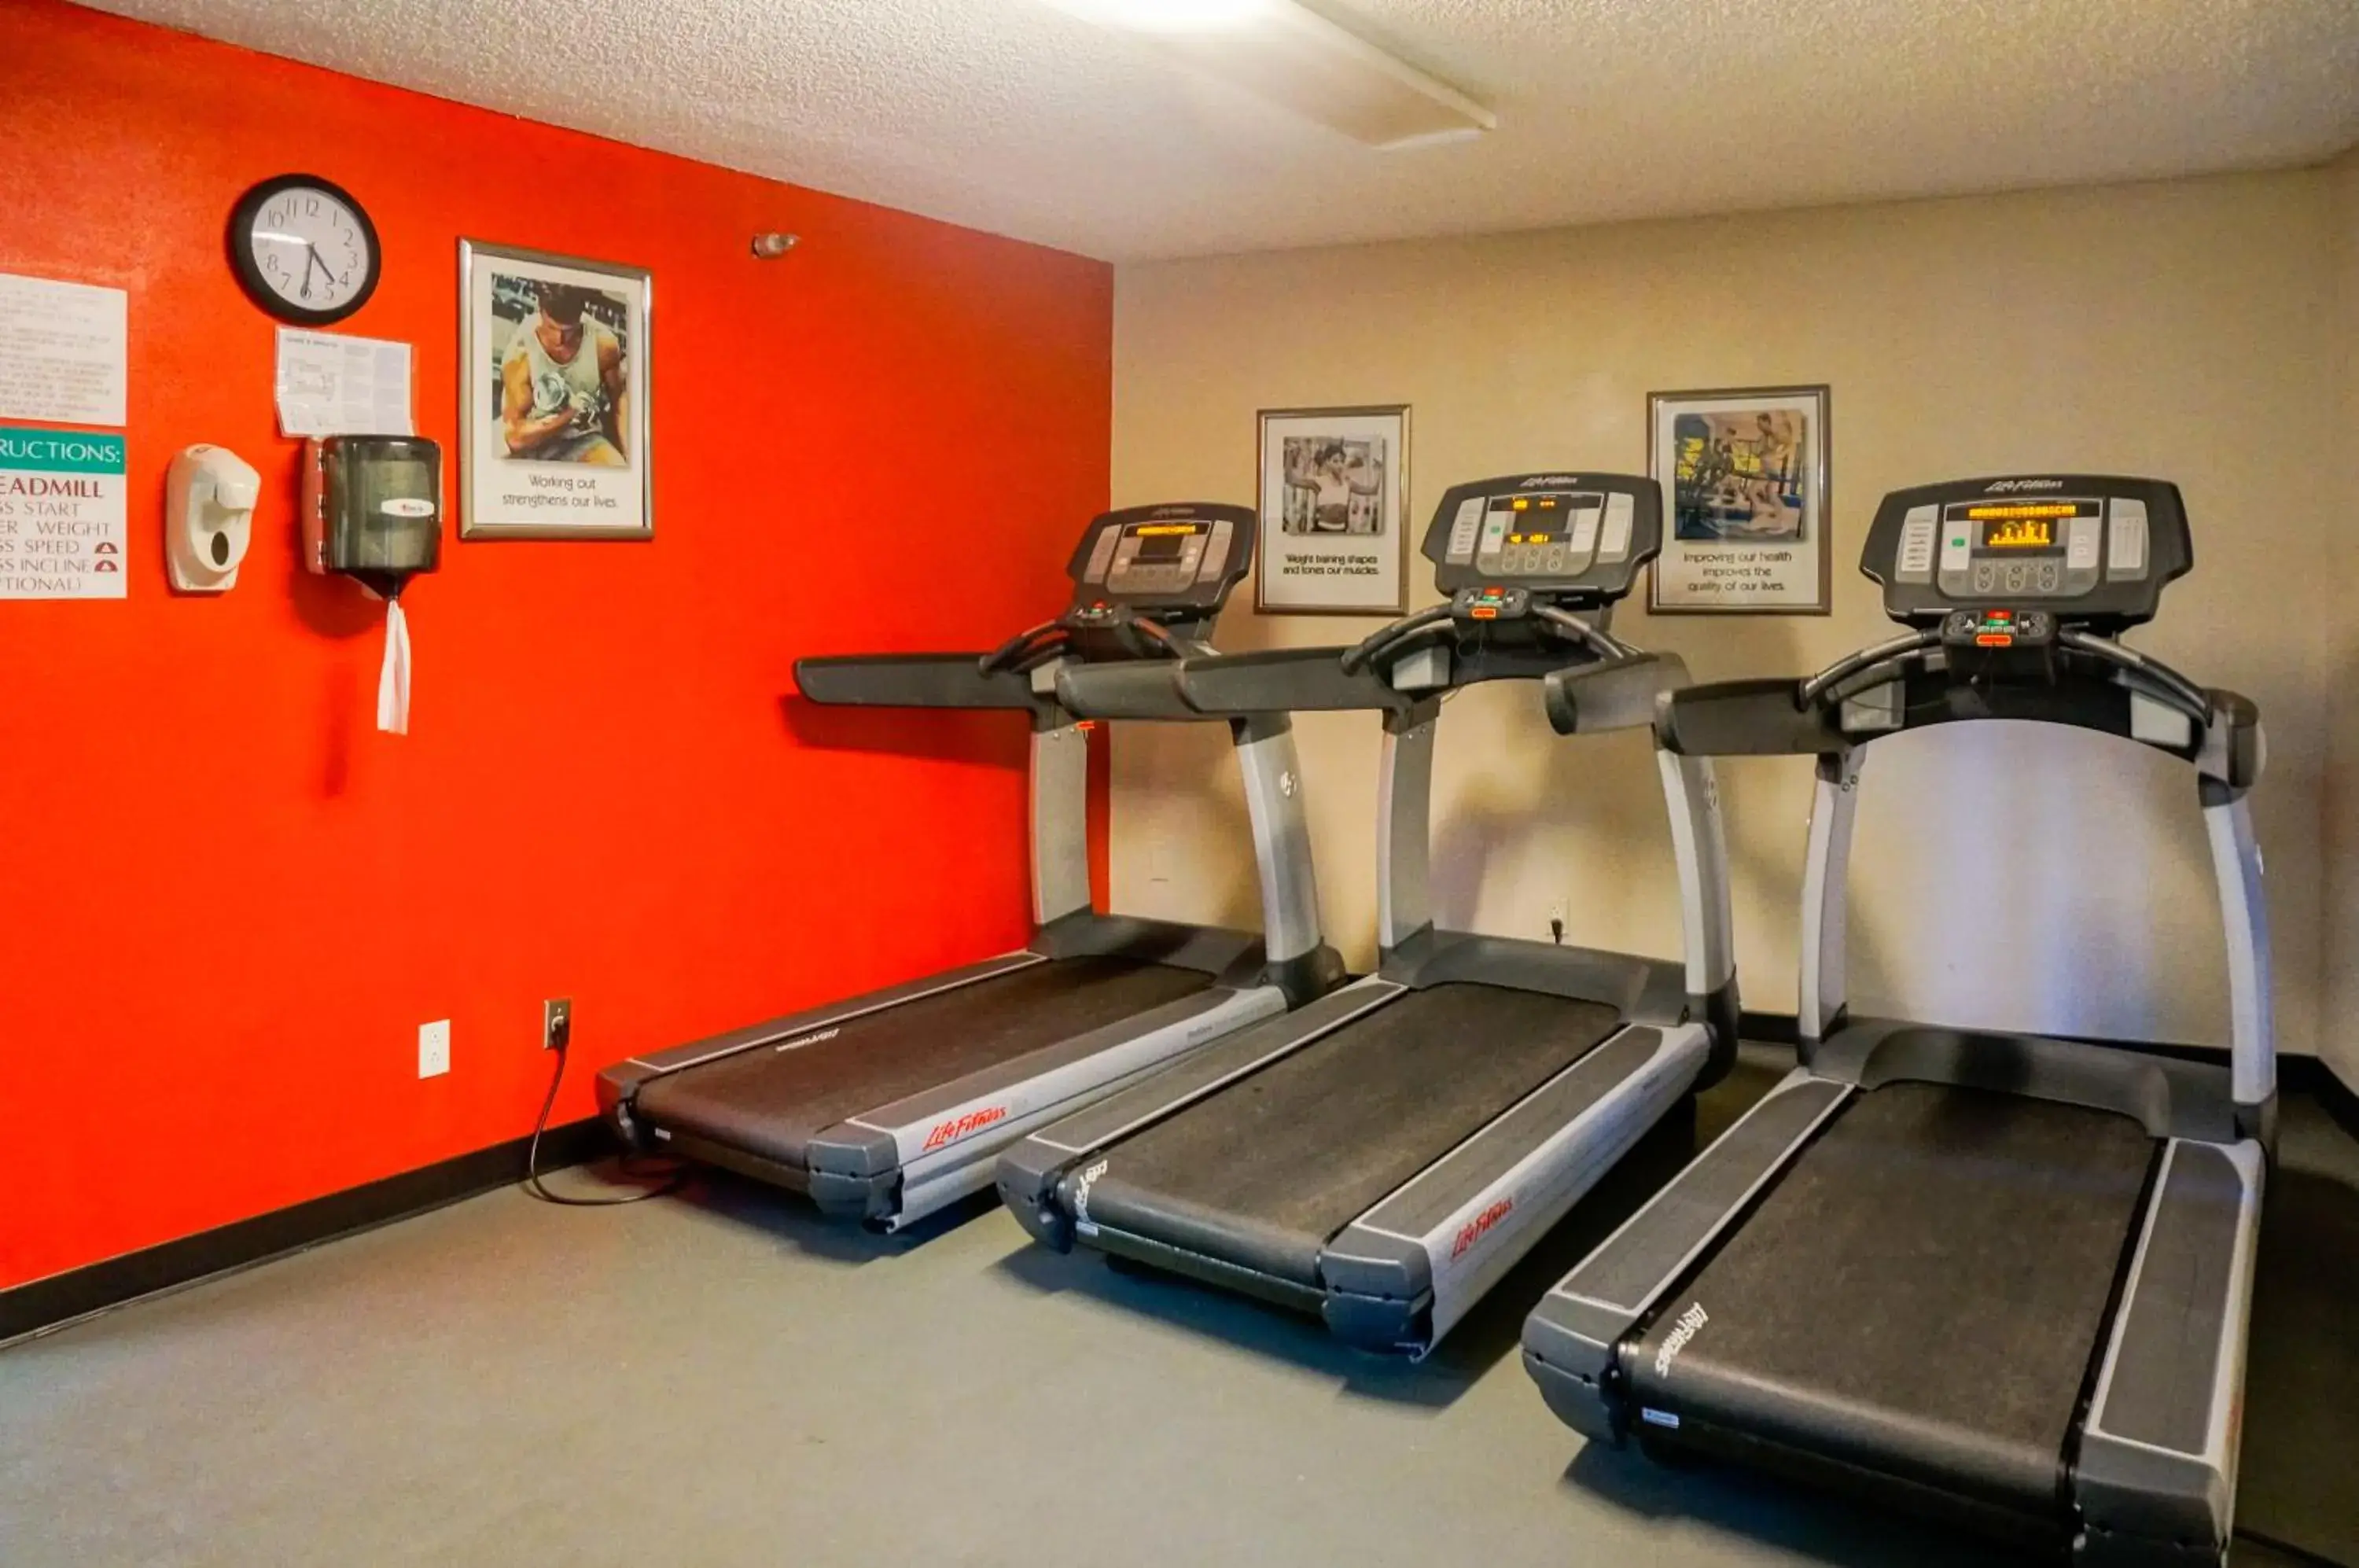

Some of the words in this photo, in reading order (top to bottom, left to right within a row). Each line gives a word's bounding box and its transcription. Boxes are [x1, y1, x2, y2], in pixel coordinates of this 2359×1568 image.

[285, 198, 297, 219] 11
[305, 196, 319, 217] 12
[267, 209, 285, 228] 10
[333, 209, 338, 227] 1
[344, 228, 354, 248] 2
[267, 253, 278, 272] 8
[348, 251, 358, 270] 3
[281, 271, 292, 290] 7
[339, 271, 349, 288] 4
[324, 280, 335, 300] 5
[0, 476, 104, 498] EADMILL
[528, 473, 573, 491] Working
[576, 478, 596, 490] out
[24, 502, 81, 517] START
[502, 494, 569, 508] strengthens
[572, 497, 591, 507] our
[36, 521, 111, 536] WEIGHT
[24, 539, 79, 554] SPEED
[20, 558, 91, 573] INCLINE
[1285, 554, 1314, 565] Weight
[1684, 552, 1735, 564] Improving
[1739, 553, 1757, 562] our
[1759, 551, 1792, 562] health
[1283, 566, 1300, 575] and
[1702, 566, 1751, 577] improves
[1754, 566, 1772, 576] the
[1724, 580, 1738, 591] of
[1739, 582, 1757, 591] our
